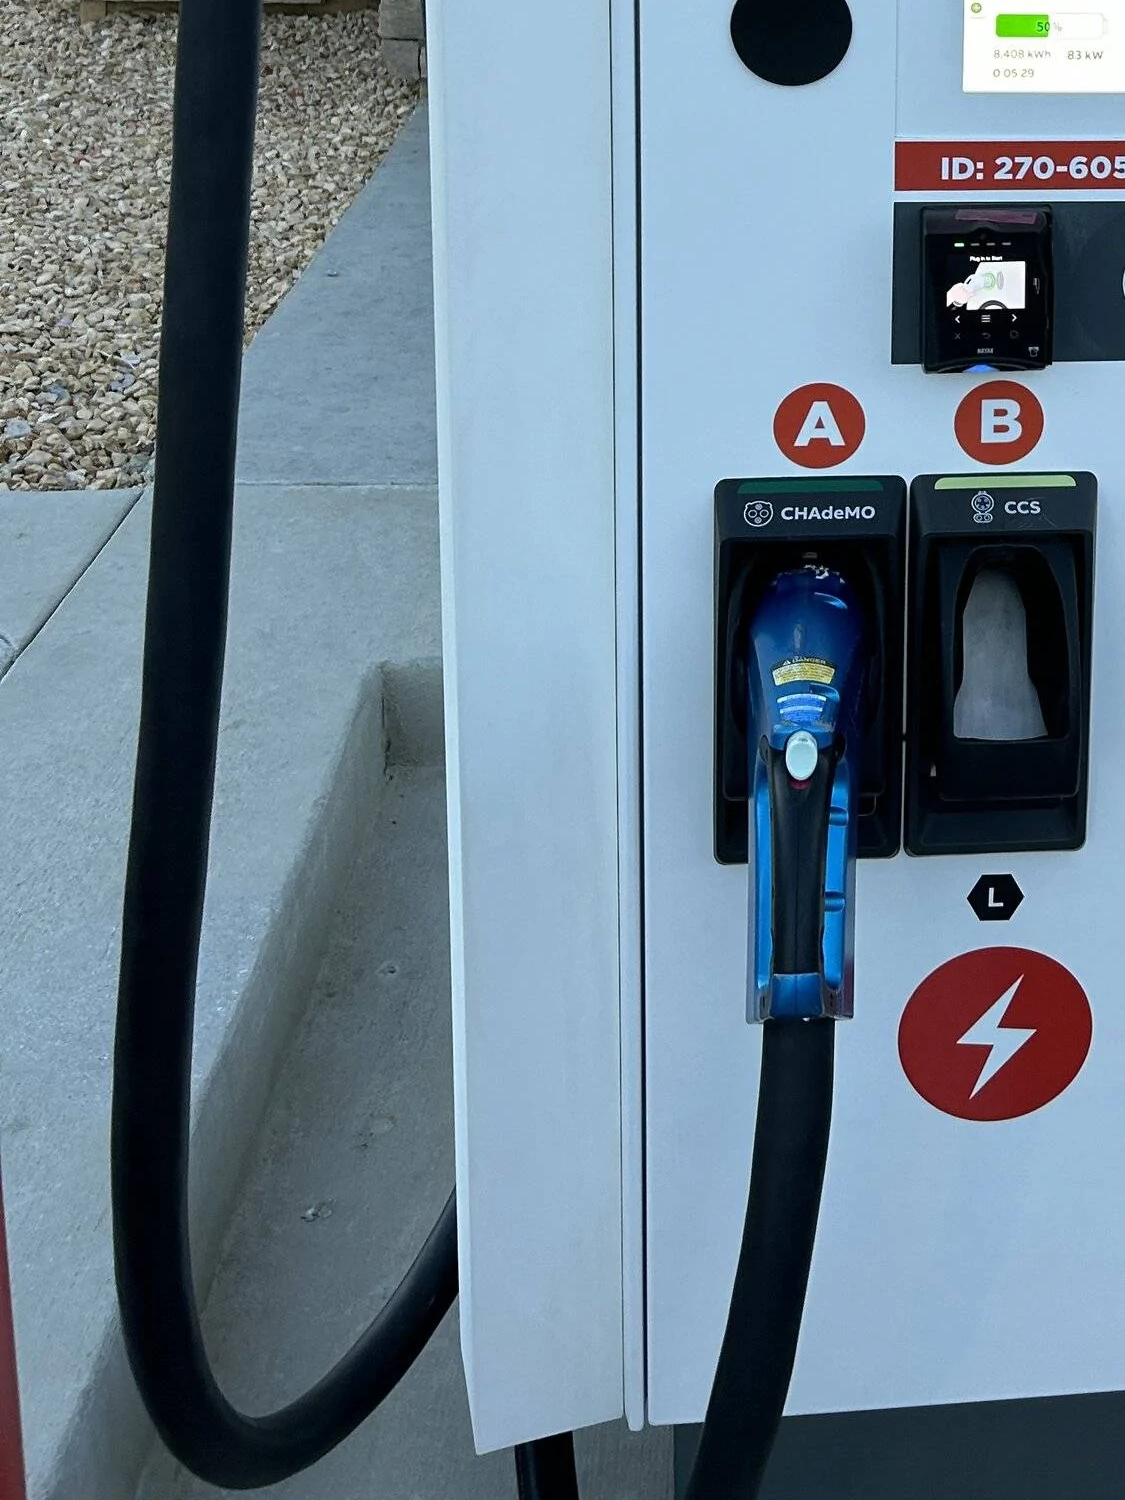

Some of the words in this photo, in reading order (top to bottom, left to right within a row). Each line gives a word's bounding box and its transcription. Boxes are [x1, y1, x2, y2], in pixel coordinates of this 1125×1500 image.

[1036, 21, 1051, 32] 50
[1027, 49, 1051, 59] kWh
[1067, 50, 1082, 60] 83
[1085, 50, 1104, 60] kW
[940, 156, 984, 180] ID:
[793, 401, 845, 447] A
[980, 399, 1023, 444] B
[780, 505, 876, 521] CHAdeMO
[1004, 500, 1041, 515] CCS
[987, 887, 1004, 907] L
